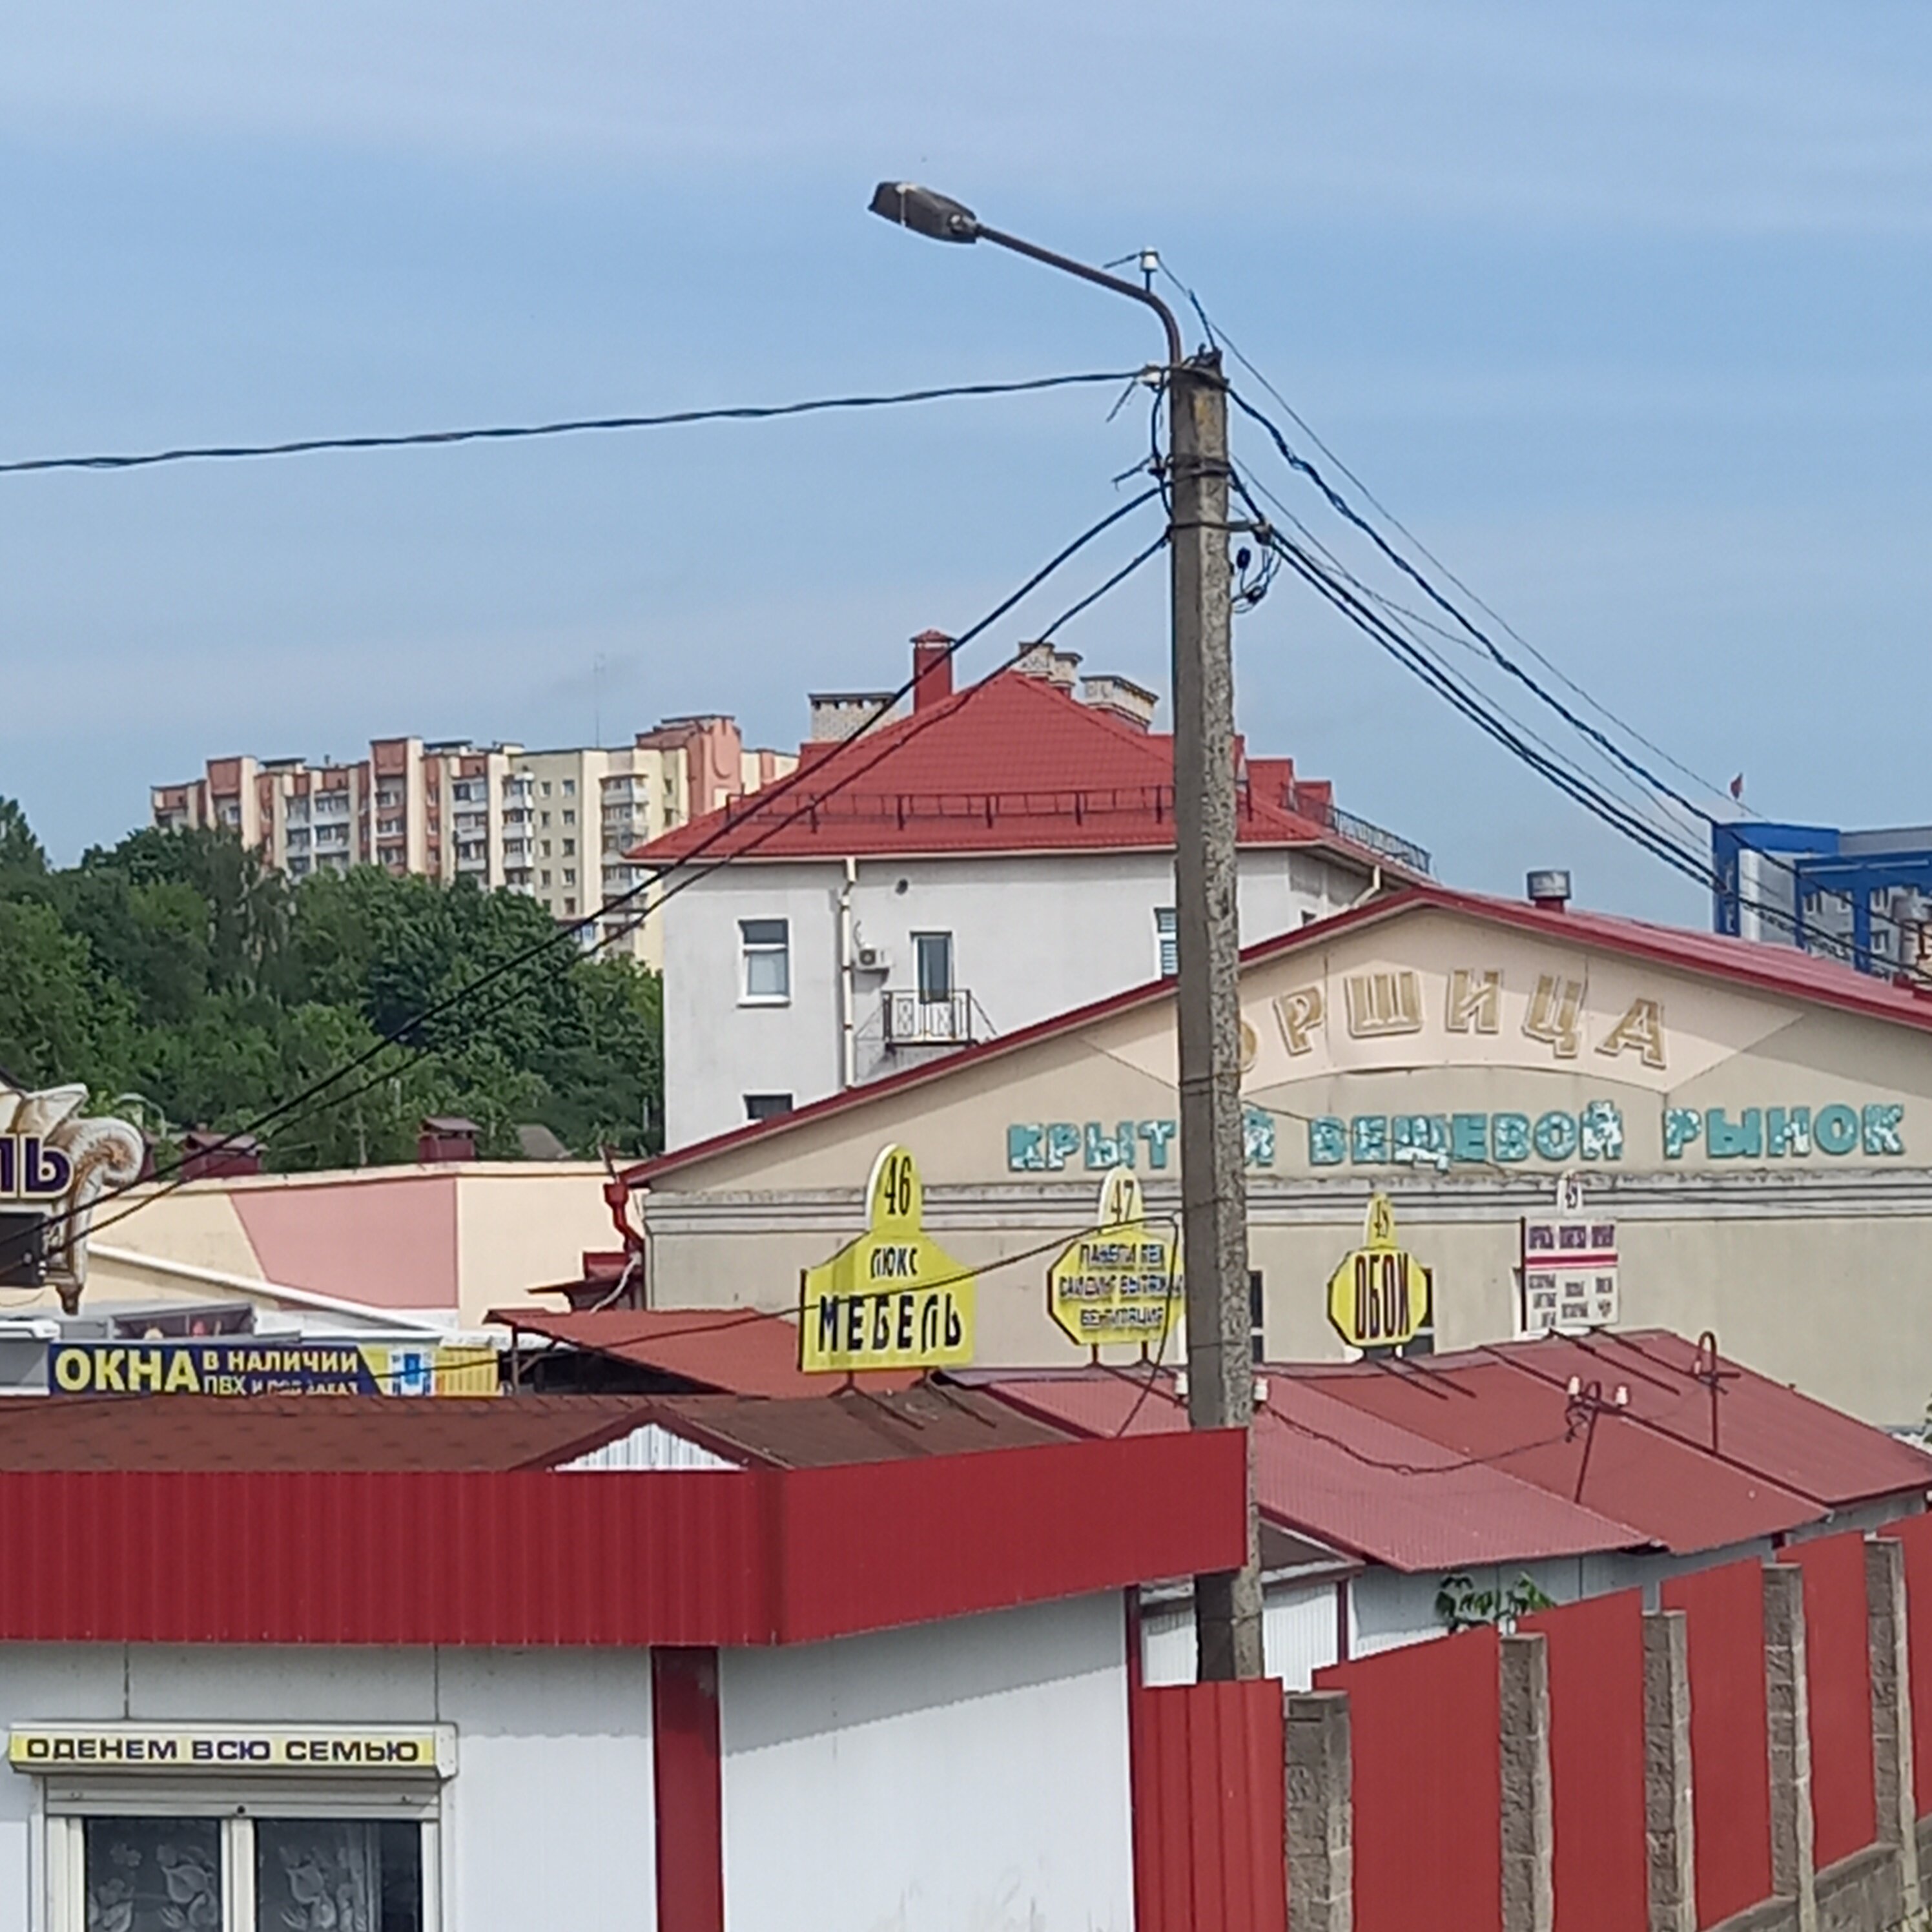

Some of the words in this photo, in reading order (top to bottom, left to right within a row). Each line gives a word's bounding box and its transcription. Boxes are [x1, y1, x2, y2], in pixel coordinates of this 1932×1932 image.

[1007, 1108, 1275, 1171] КРЫТЙ
[1310, 1100, 1623, 1172] ВЕЩЕВОЙ
[1663, 1104, 1905, 1158] РЫНОК
[884, 1155, 911, 1217] 46
[1110, 1180, 1134, 1224] 47
[870, 1244, 918, 1279] ЛЮКС
[1355, 1252, 1410, 1340] ОБОИ
[817, 1293, 961, 1354] МЕБЕЛЬ
[55, 1348, 201, 1392] ОКНА
[203, 1350, 219, 1371] В
[227, 1351, 358, 1373] НАЛИЧИИ
[203, 1375, 247, 1395] ПВХ
[26, 1738, 178, 1760] ОДЕНЕМ
[192, 1739, 270, 1761] ВСЮ
[285, 1740, 419, 1762] СЕМЬЮ
